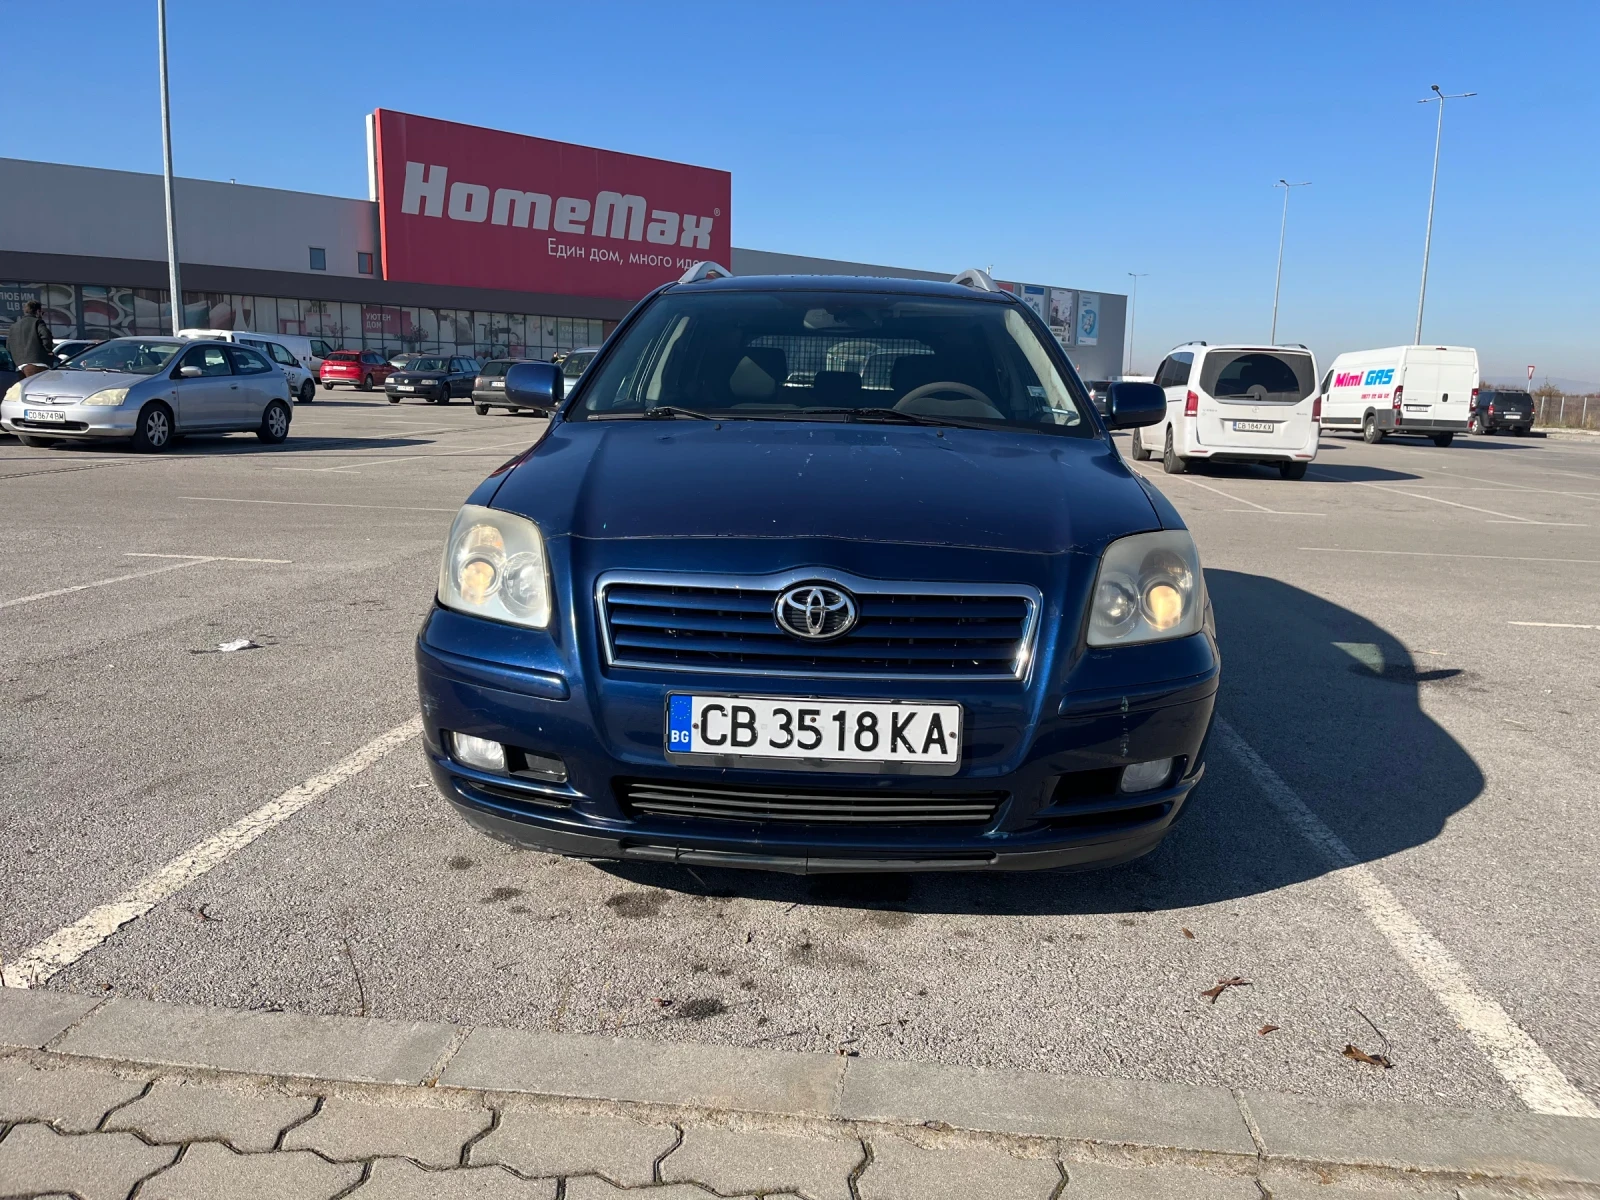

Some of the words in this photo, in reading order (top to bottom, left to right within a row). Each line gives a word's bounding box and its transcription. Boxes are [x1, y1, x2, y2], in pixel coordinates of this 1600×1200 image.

[401, 161, 714, 249] HomeMax
[547, 237, 585, 258] Един
[590, 248, 624, 265] дом,
[629, 252, 672, 268] много
[676, 257, 703, 270] иде
[366, 313, 391, 321] УЮТЕН
[366, 321, 382, 330] ДОМ
[1334, 371, 1364, 388] Mimi
[1364, 368, 1395, 386] GAS
[671, 729, 690, 743] BG
[700, 703, 758, 748] CB
[769, 707, 879, 752] 3518
[891, 711, 949, 755] KA
